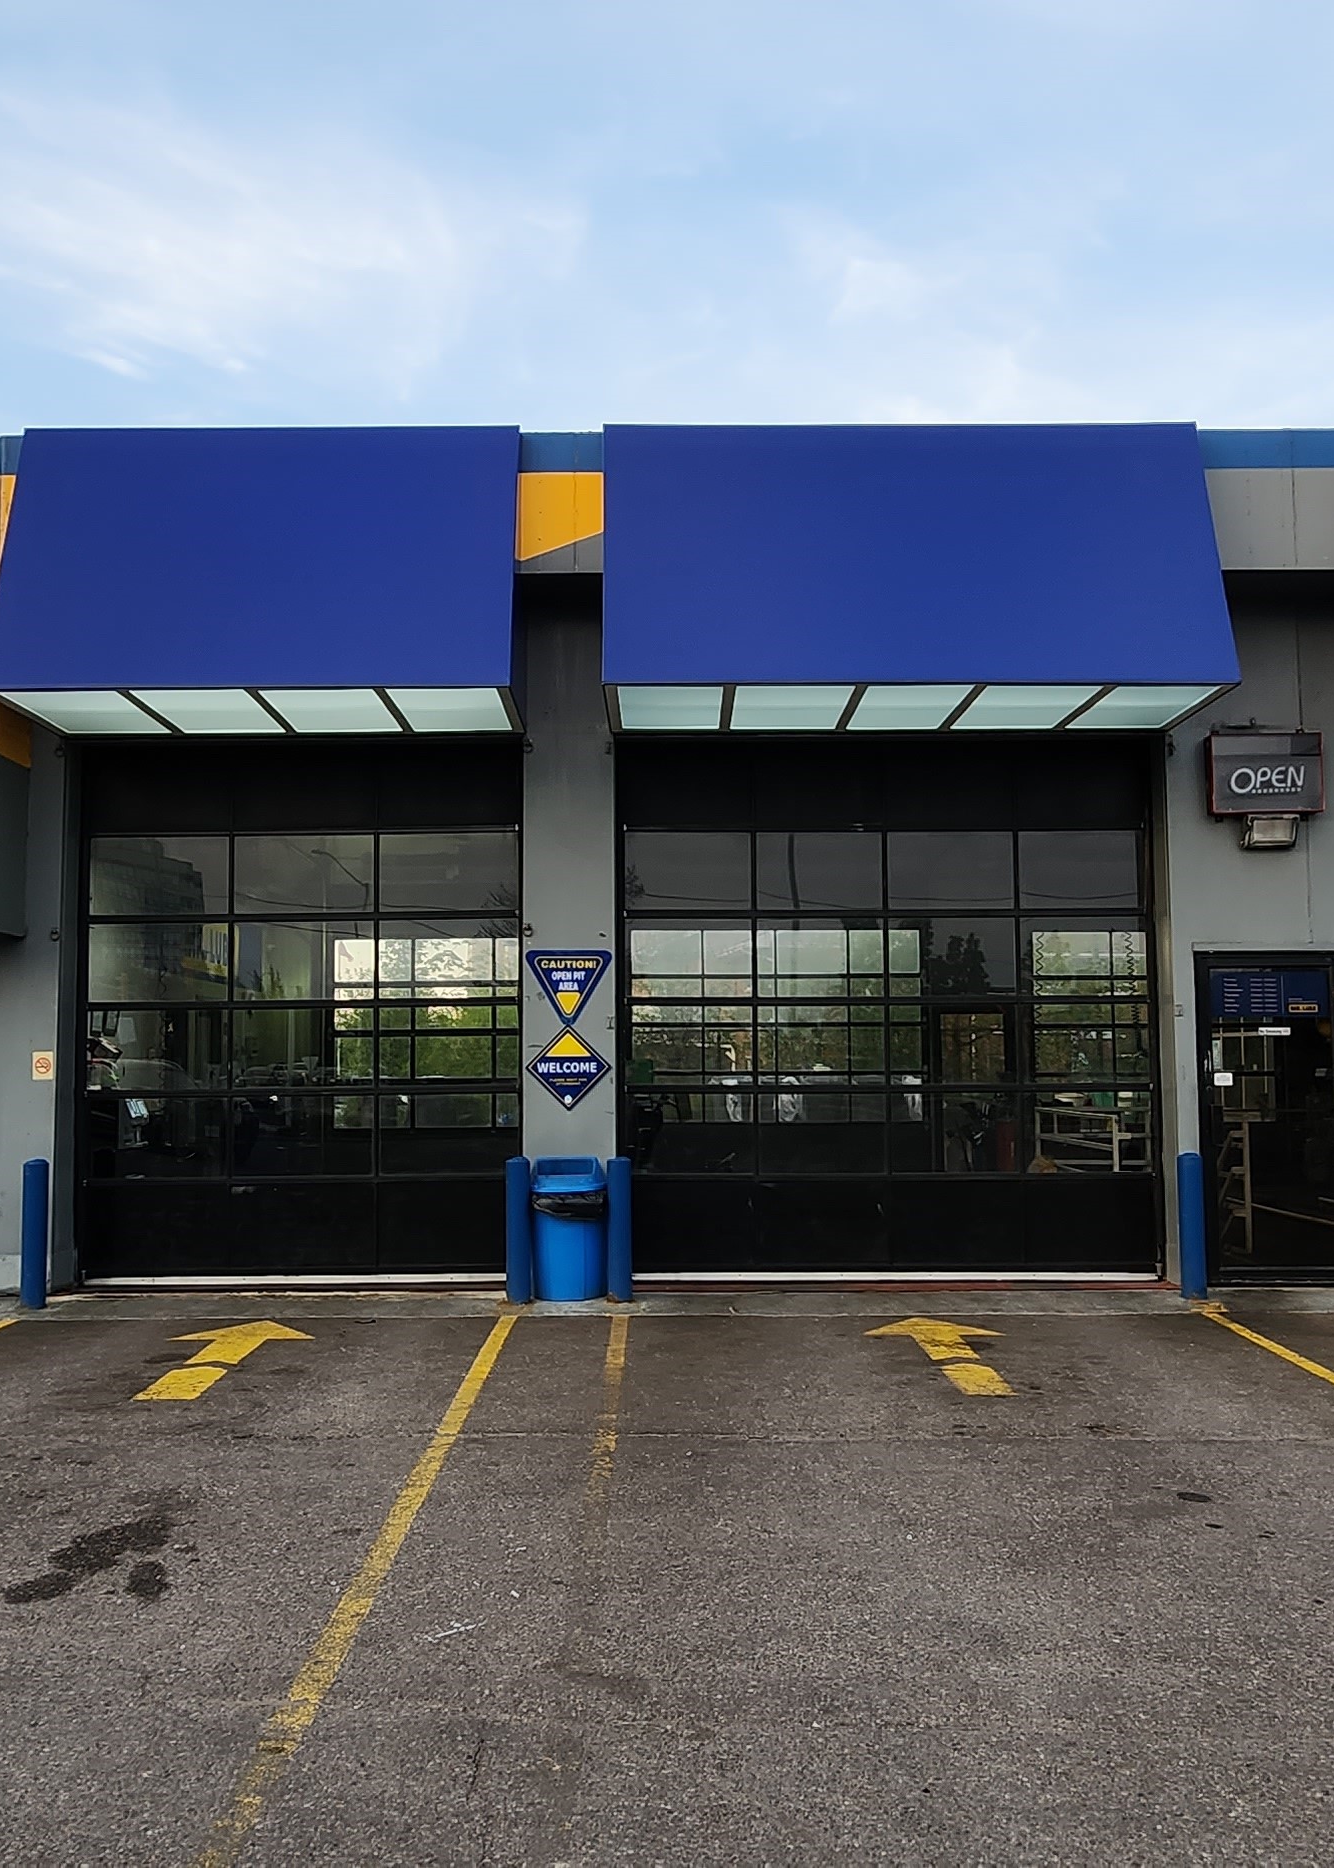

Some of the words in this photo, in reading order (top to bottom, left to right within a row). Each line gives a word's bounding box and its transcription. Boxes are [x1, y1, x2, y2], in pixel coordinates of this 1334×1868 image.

[1230, 765, 1305, 794] OPEN
[540, 960, 597, 969] CAUTION!
[551, 971, 572, 980] OPEN
[573, 971, 586, 980] PIT
[558, 982, 579, 991] AREA
[537, 1062, 597, 1073] WELCOME
